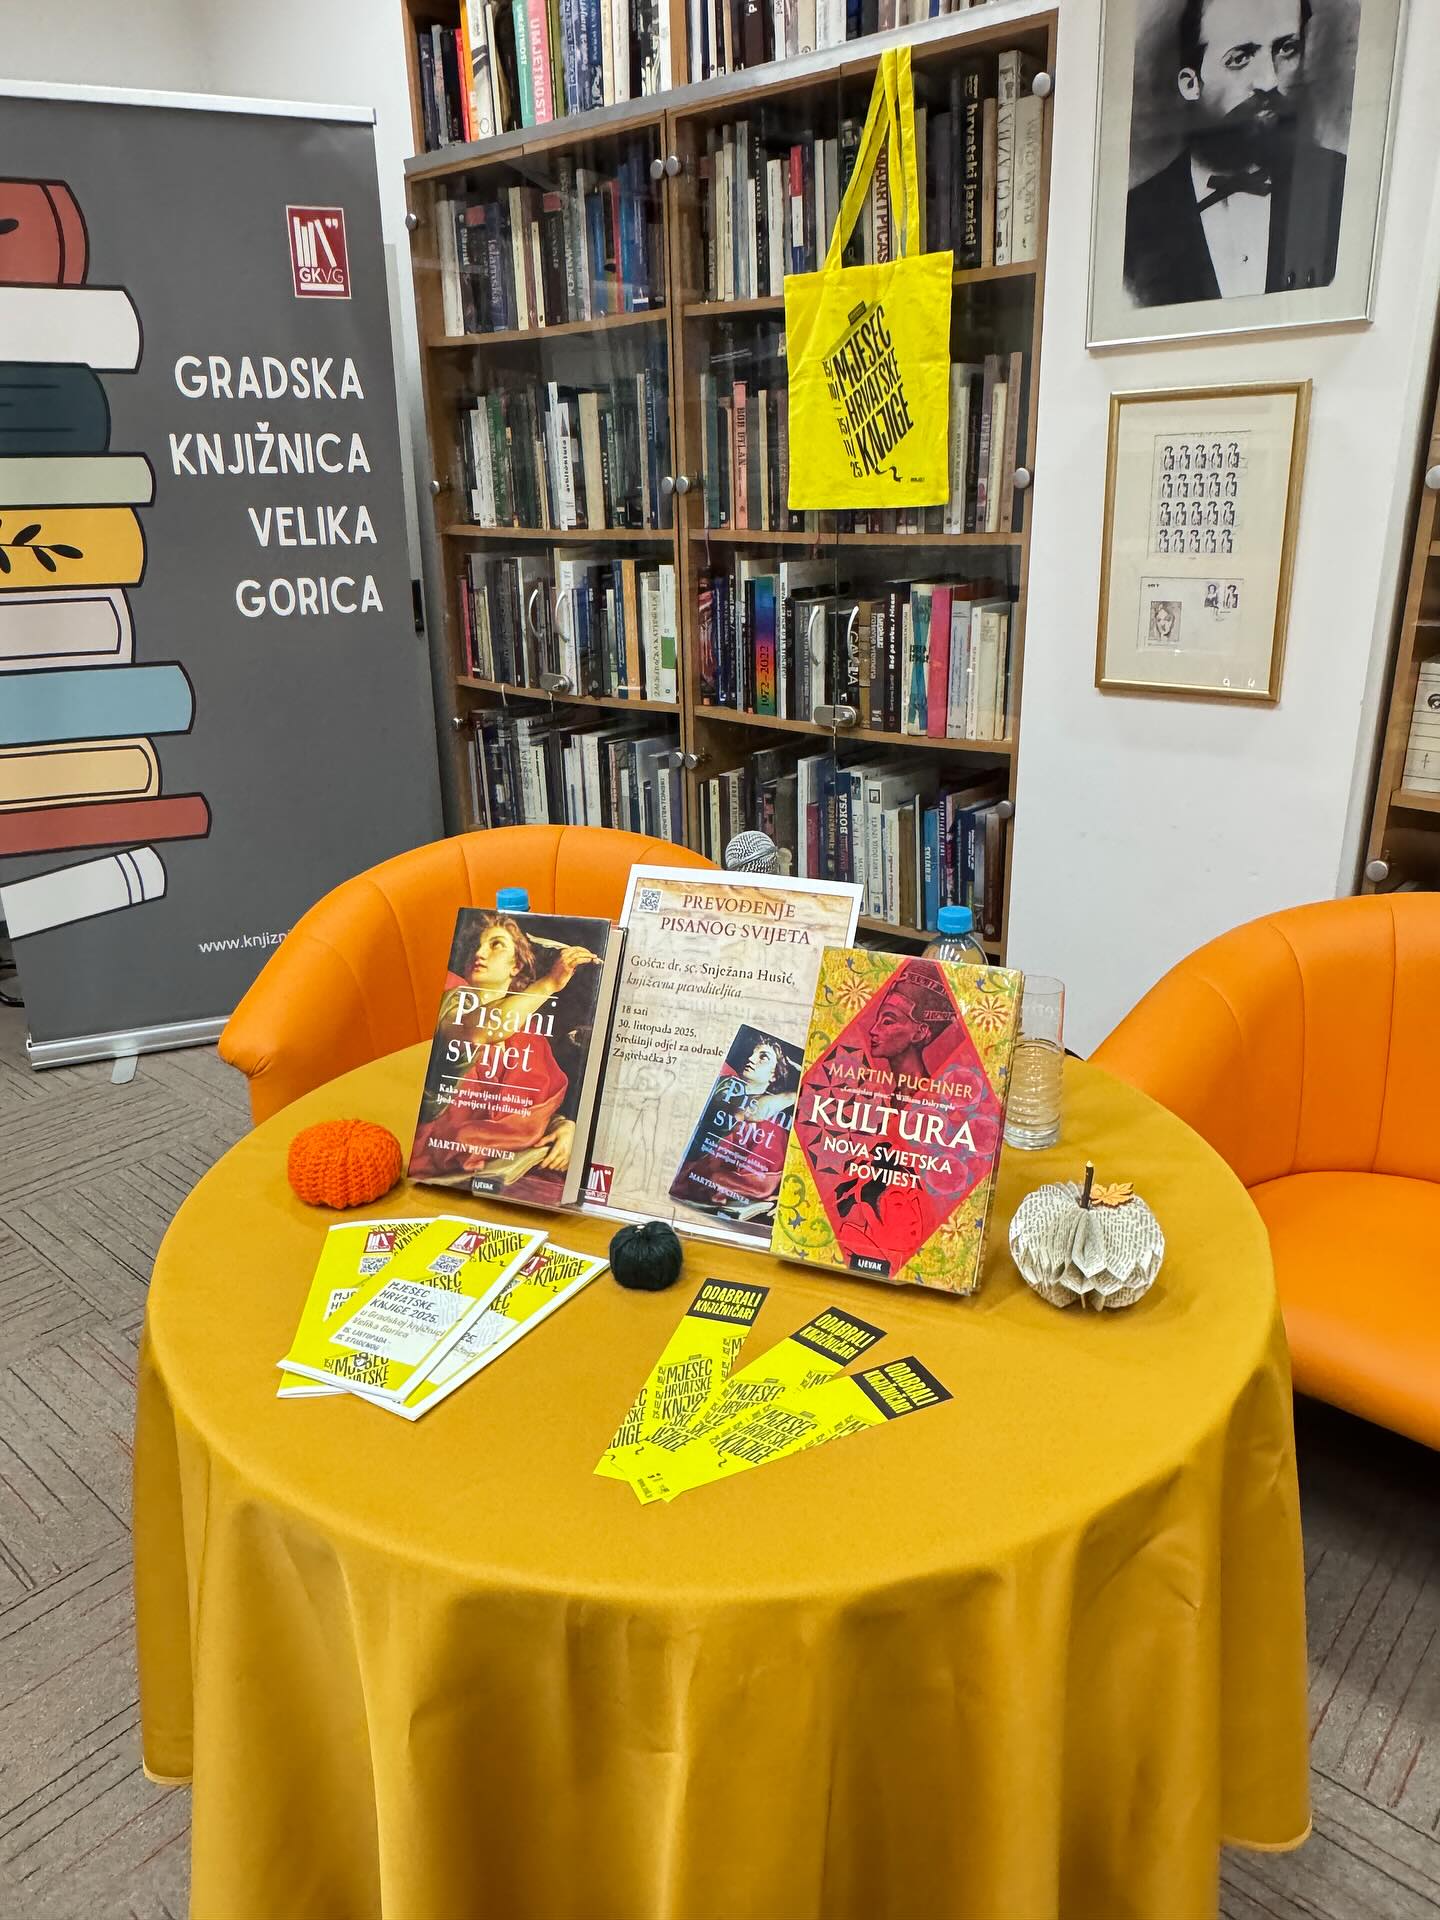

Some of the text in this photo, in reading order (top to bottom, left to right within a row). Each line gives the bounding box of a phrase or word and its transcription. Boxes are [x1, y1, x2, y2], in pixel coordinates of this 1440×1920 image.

[530, 17, 547, 118] UMJETNOST
[965, 103, 979, 181] hrvatski
[298, 266, 345, 284] GKVG
[832, 305, 891, 397] MJESEC
[174, 355, 364, 400] GRADSKA
[844, 347, 902, 432] HRVATSKE
[736, 407, 747, 467] BOB DYLAN
[855, 383, 914, 476] KNJIGE
[169, 421, 371, 476] KNJIŽNICA
[247, 505, 378, 547] VELIKA
[235, 575, 384, 619] GORICA
[838, 792, 849, 834] BOKSA
[682, 894, 796, 921] PREVOĐENJE
[660, 917, 811, 946] PISANOG SVIJETA
[626, 973, 675, 992] književna
[630, 955, 666, 971] Gošća:
[667, 958, 682, 973] dr.
[700, 962, 754, 982] Snježana
[451, 990, 559, 1038] Pisani
[621, 1004, 649, 1017] 18 sati
[617, 1019, 631, 1030] 30.
[633, 1020, 673, 1036] listopada
[446, 1030, 535, 1079] svijet
[612, 1047, 678, 1066] Zagrebačka 37
[654, 1038, 678, 1053] odjel
[678, 1043, 690, 1053] za
[690, 1042, 725, 1058] odrasle
[439, 1083, 459, 1095] Kako
[829, 1063, 974, 1099] MARTIN PUCHNER
[713, 1110, 777, 1150] svijet
[809, 1095, 977, 1152] KULTURA
[428, 1137, 516, 1161] MARTIN PUCHNER
[823, 1136, 953, 1175] NOVA SVJETSKA
[848, 1162, 921, 1189] POVIJEST
[479, 1233, 526, 1263] KNJIGE
[533, 1260, 585, 1287] KNJIGE
[857, 1258, 883, 1272] LJEVAK
[379, 1290, 436, 1311] HRVATSKE
[388, 1281, 431, 1298] MJESEC
[701, 1284, 762, 1308] ODABRALI
[367, 1308, 407, 1328] Gradskoj
[370, 1298, 411, 1316] KNJIGE
[693, 1300, 754, 1321] KNJIŽNIČARI
[352, 1317, 410, 1339] Velika Gorica
[814, 1312, 876, 1348] ODABRALI
[799, 1325, 860, 1361] KNJIŽNIČARI
[665, 1358, 713, 1385] MJESEC
[885, 1361, 940, 1407] ODABRALI
[663, 1376, 713, 1400] HRVATSKE
[738, 1423, 799, 1450] HRVATSKE
[755, 1409, 818, 1438] MJESEC
[713, 1434, 780, 1465] KNJIGE
